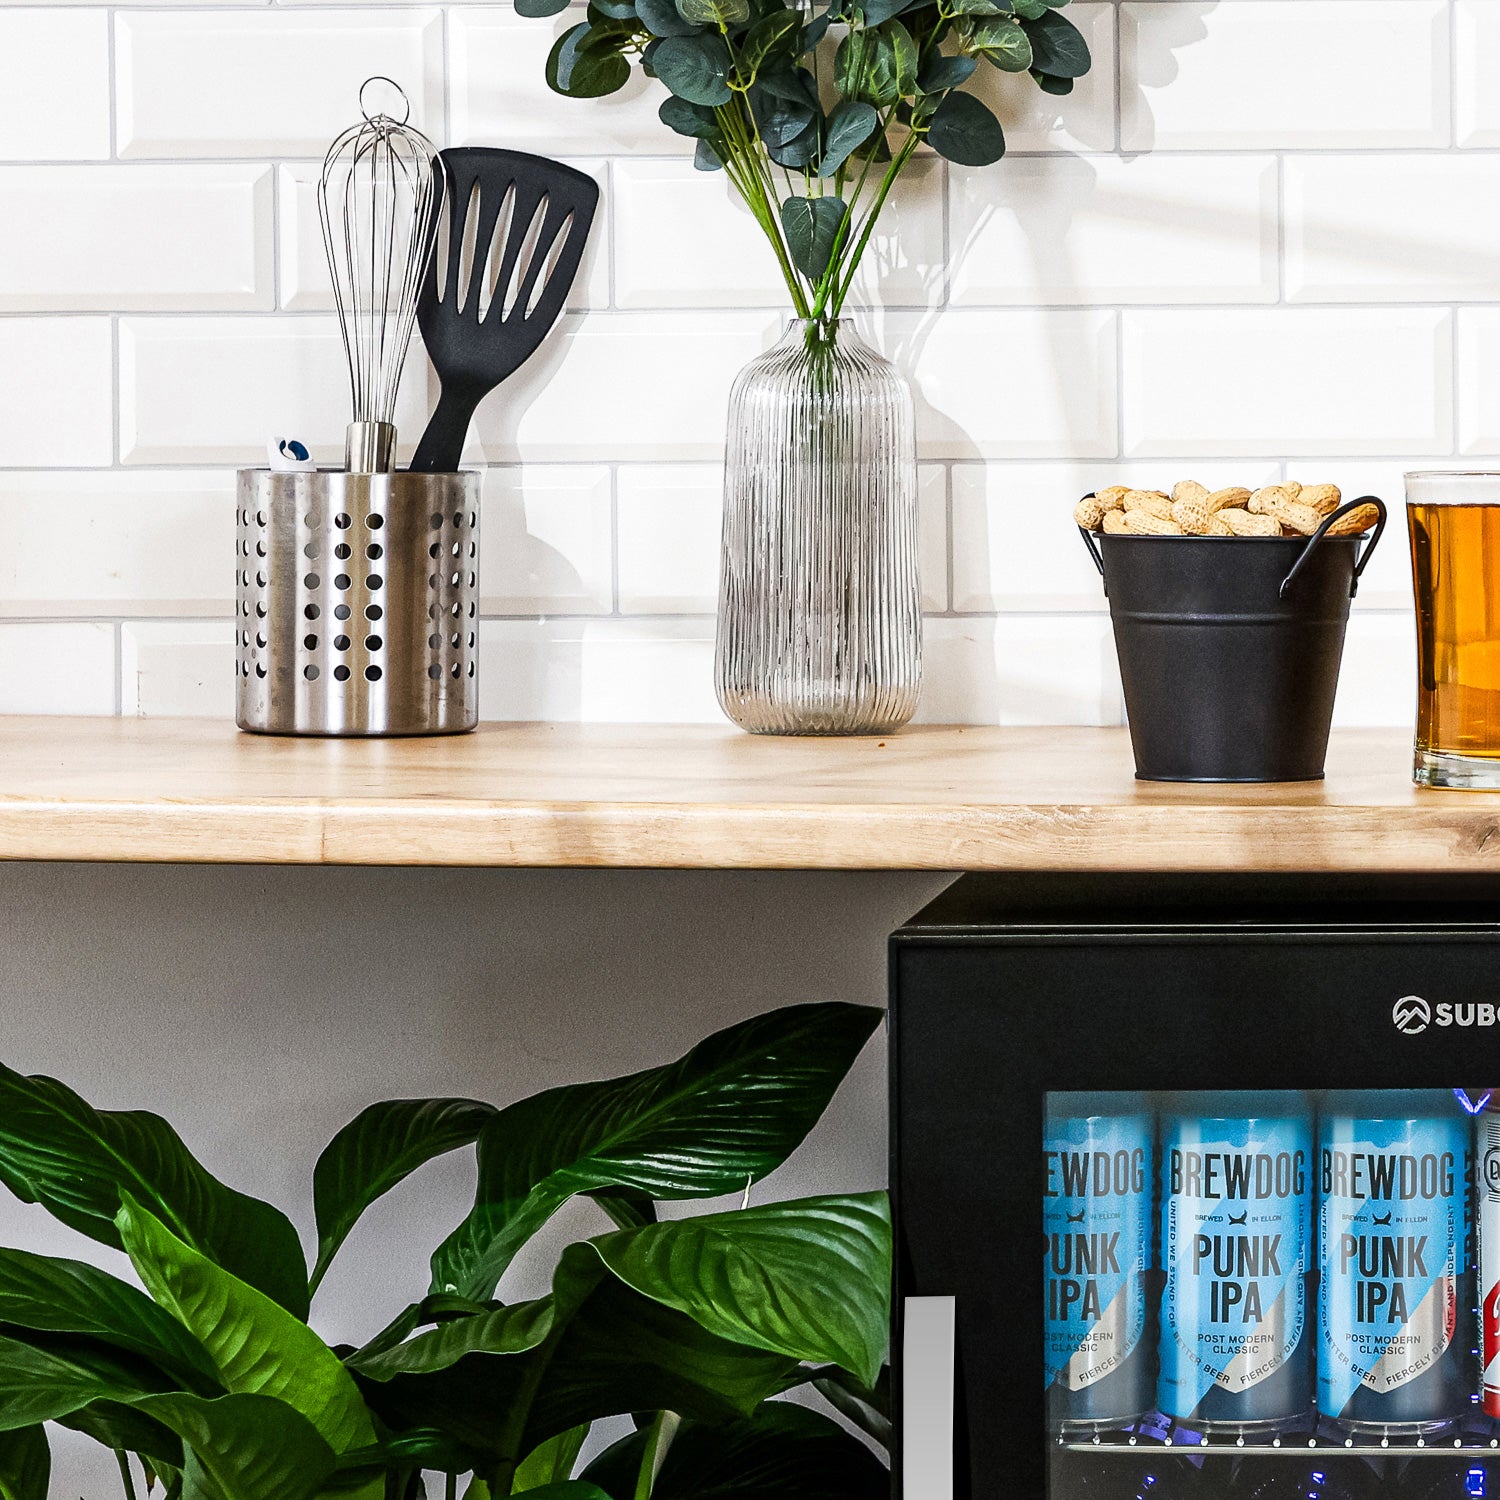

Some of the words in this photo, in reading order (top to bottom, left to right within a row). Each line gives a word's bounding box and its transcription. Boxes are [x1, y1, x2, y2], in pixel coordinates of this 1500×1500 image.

[1044, 1148, 1144, 1198] EWDOG
[1171, 1149, 1305, 1199] BREWDOG
[1322, 1148, 1454, 1200] BREWDOG
[1043, 1232, 1121, 1276] UNK
[1193, 1233, 1282, 1278] PUNK
[1340, 1233, 1428, 1278] PUNK
[1050, 1279, 1101, 1321] IPA
[1210, 1281, 1263, 1323] IPA
[1357, 1280, 1409, 1323] IPA
[1051, 1343, 1098, 1352] CLASSIC
[1067, 1332, 1114, 1342] MODERN
[1198, 1333, 1225, 1343] POST
[1228, 1334, 1275, 1343] MODERN
[1212, 1345, 1259, 1354] CLASSIC
[1346, 1333, 1371, 1343] POST
[1374, 1334, 1421, 1344] MODERN
[1359, 1345, 1405, 1354] CLASSIC
[1203, 1364, 1230, 1384] BEER
[1240, 1352, 1284, 1385] FIERCELY
[1350, 1363, 1377, 1384] BEER
[1386, 1353, 1431, 1385] FIERCELY
